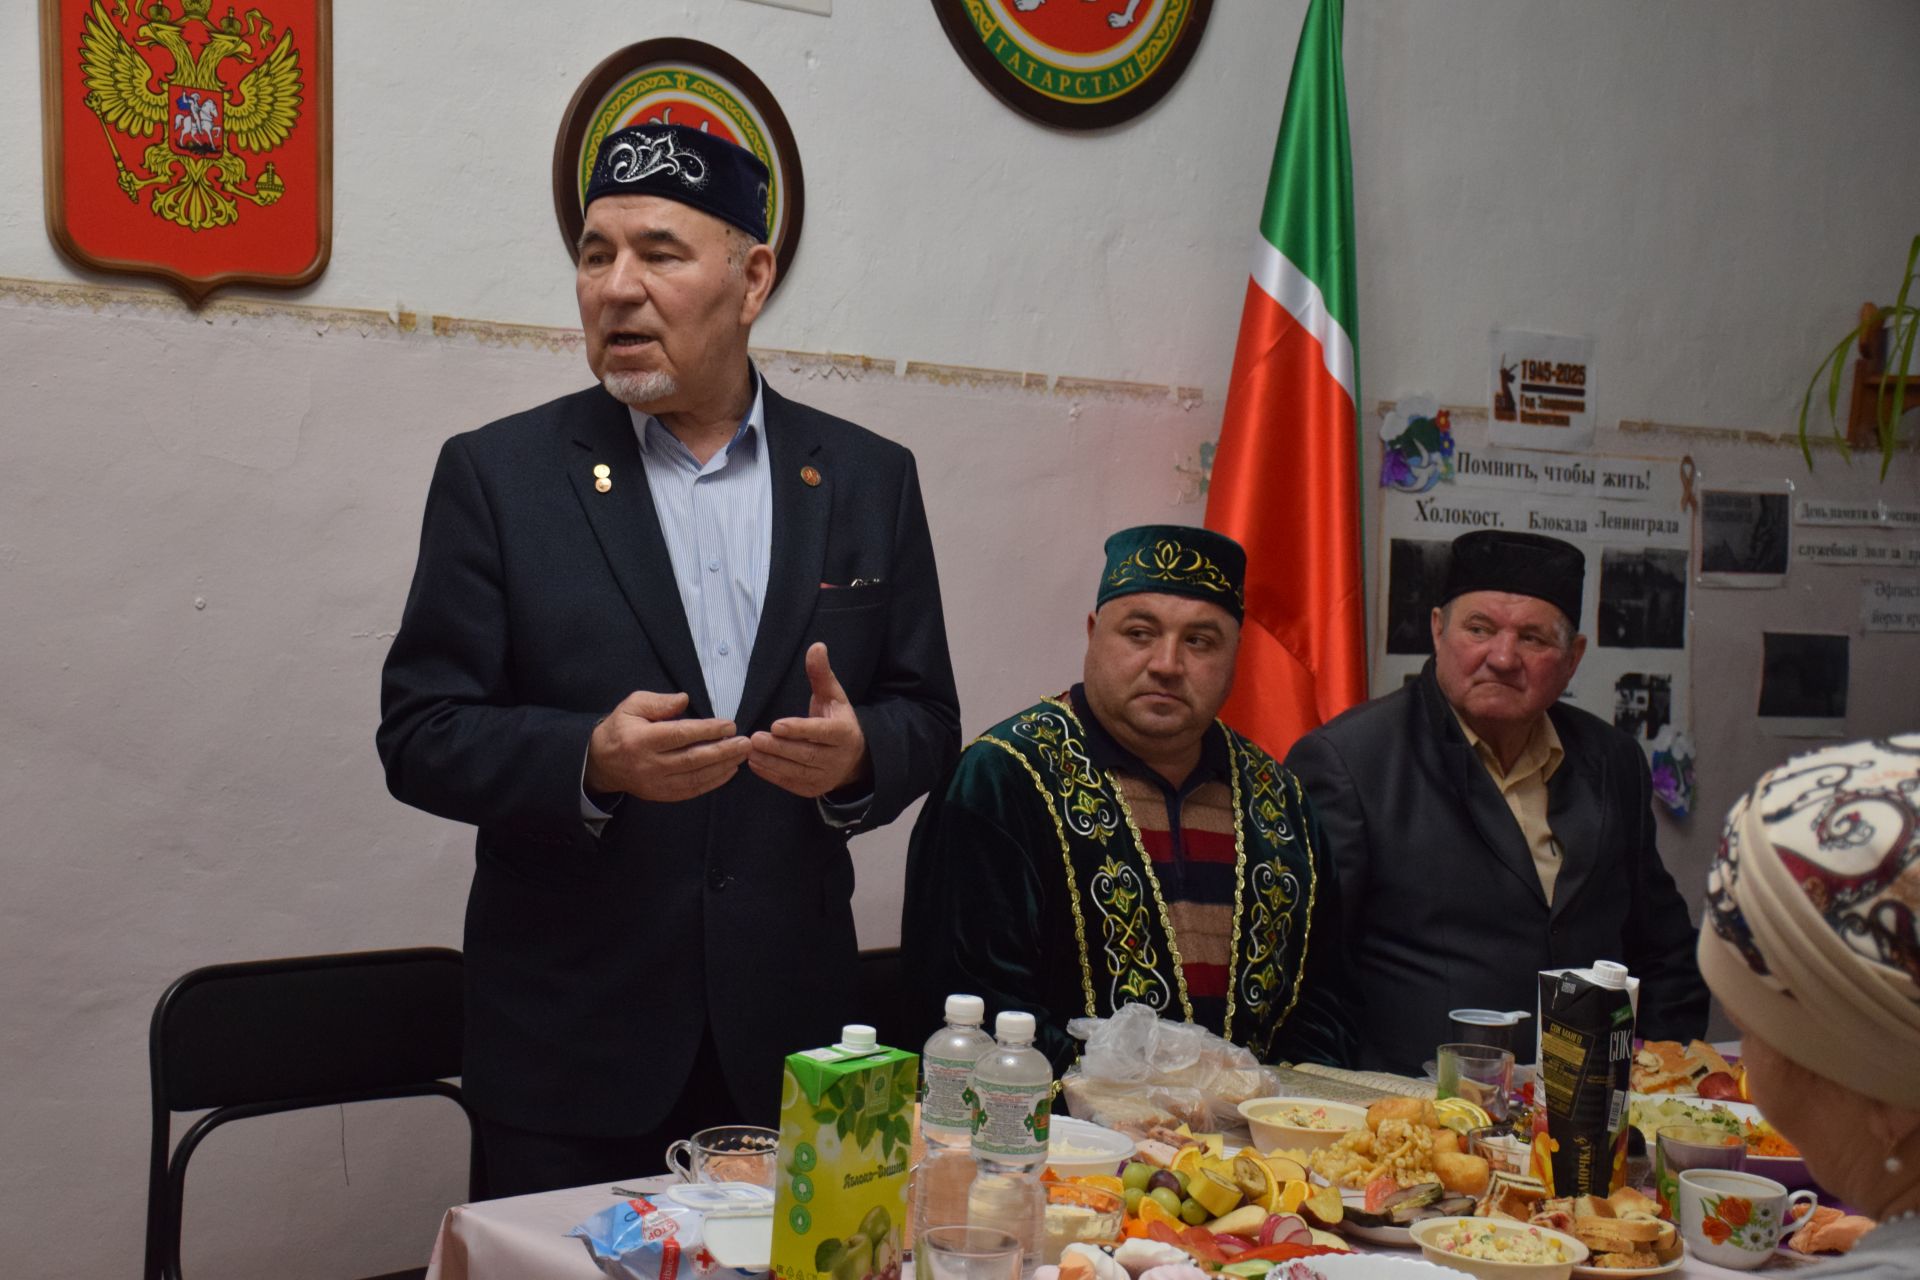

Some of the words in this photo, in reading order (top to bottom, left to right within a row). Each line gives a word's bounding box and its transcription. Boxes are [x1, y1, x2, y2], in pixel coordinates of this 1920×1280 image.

[995, 35, 1137, 95] ТАТАРСТАН
[1520, 360, 1586, 386] 1945-2025
[1457, 451, 1538, 481] Помнить,
[1544, 463, 1595, 484] чтобы
[1603, 470, 1651, 490] жить!
[1413, 498, 1505, 528] Холокост.
[1528, 512, 1587, 533] Блокада
[1595, 511, 1680, 536] Ленинграда
[1609, 1030, 1632, 1062] СОК
[1577, 1144, 1592, 1196] АНОЧКА
